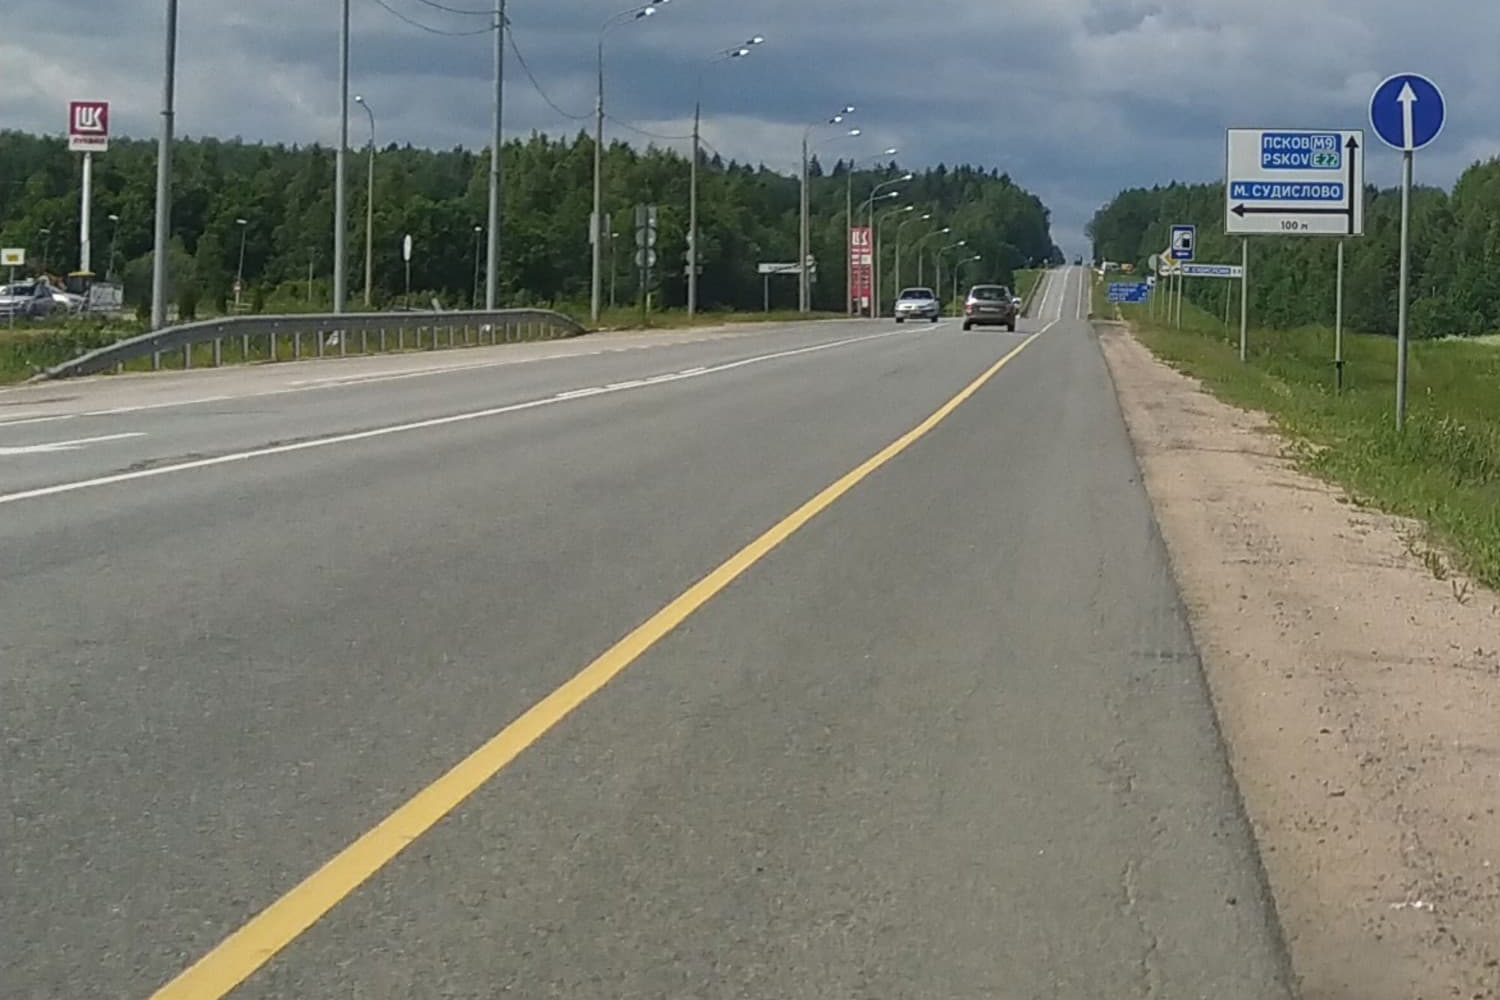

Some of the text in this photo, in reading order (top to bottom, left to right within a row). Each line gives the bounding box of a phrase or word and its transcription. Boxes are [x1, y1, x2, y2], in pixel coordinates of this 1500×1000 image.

[1263, 137, 1309, 149] ПСКОВ
[1263, 153, 1338, 165] PSKOV E22
[1234, 185, 1341, 199] М. СУДИСЛОВО
[1281, 221, 1298, 231] 100
